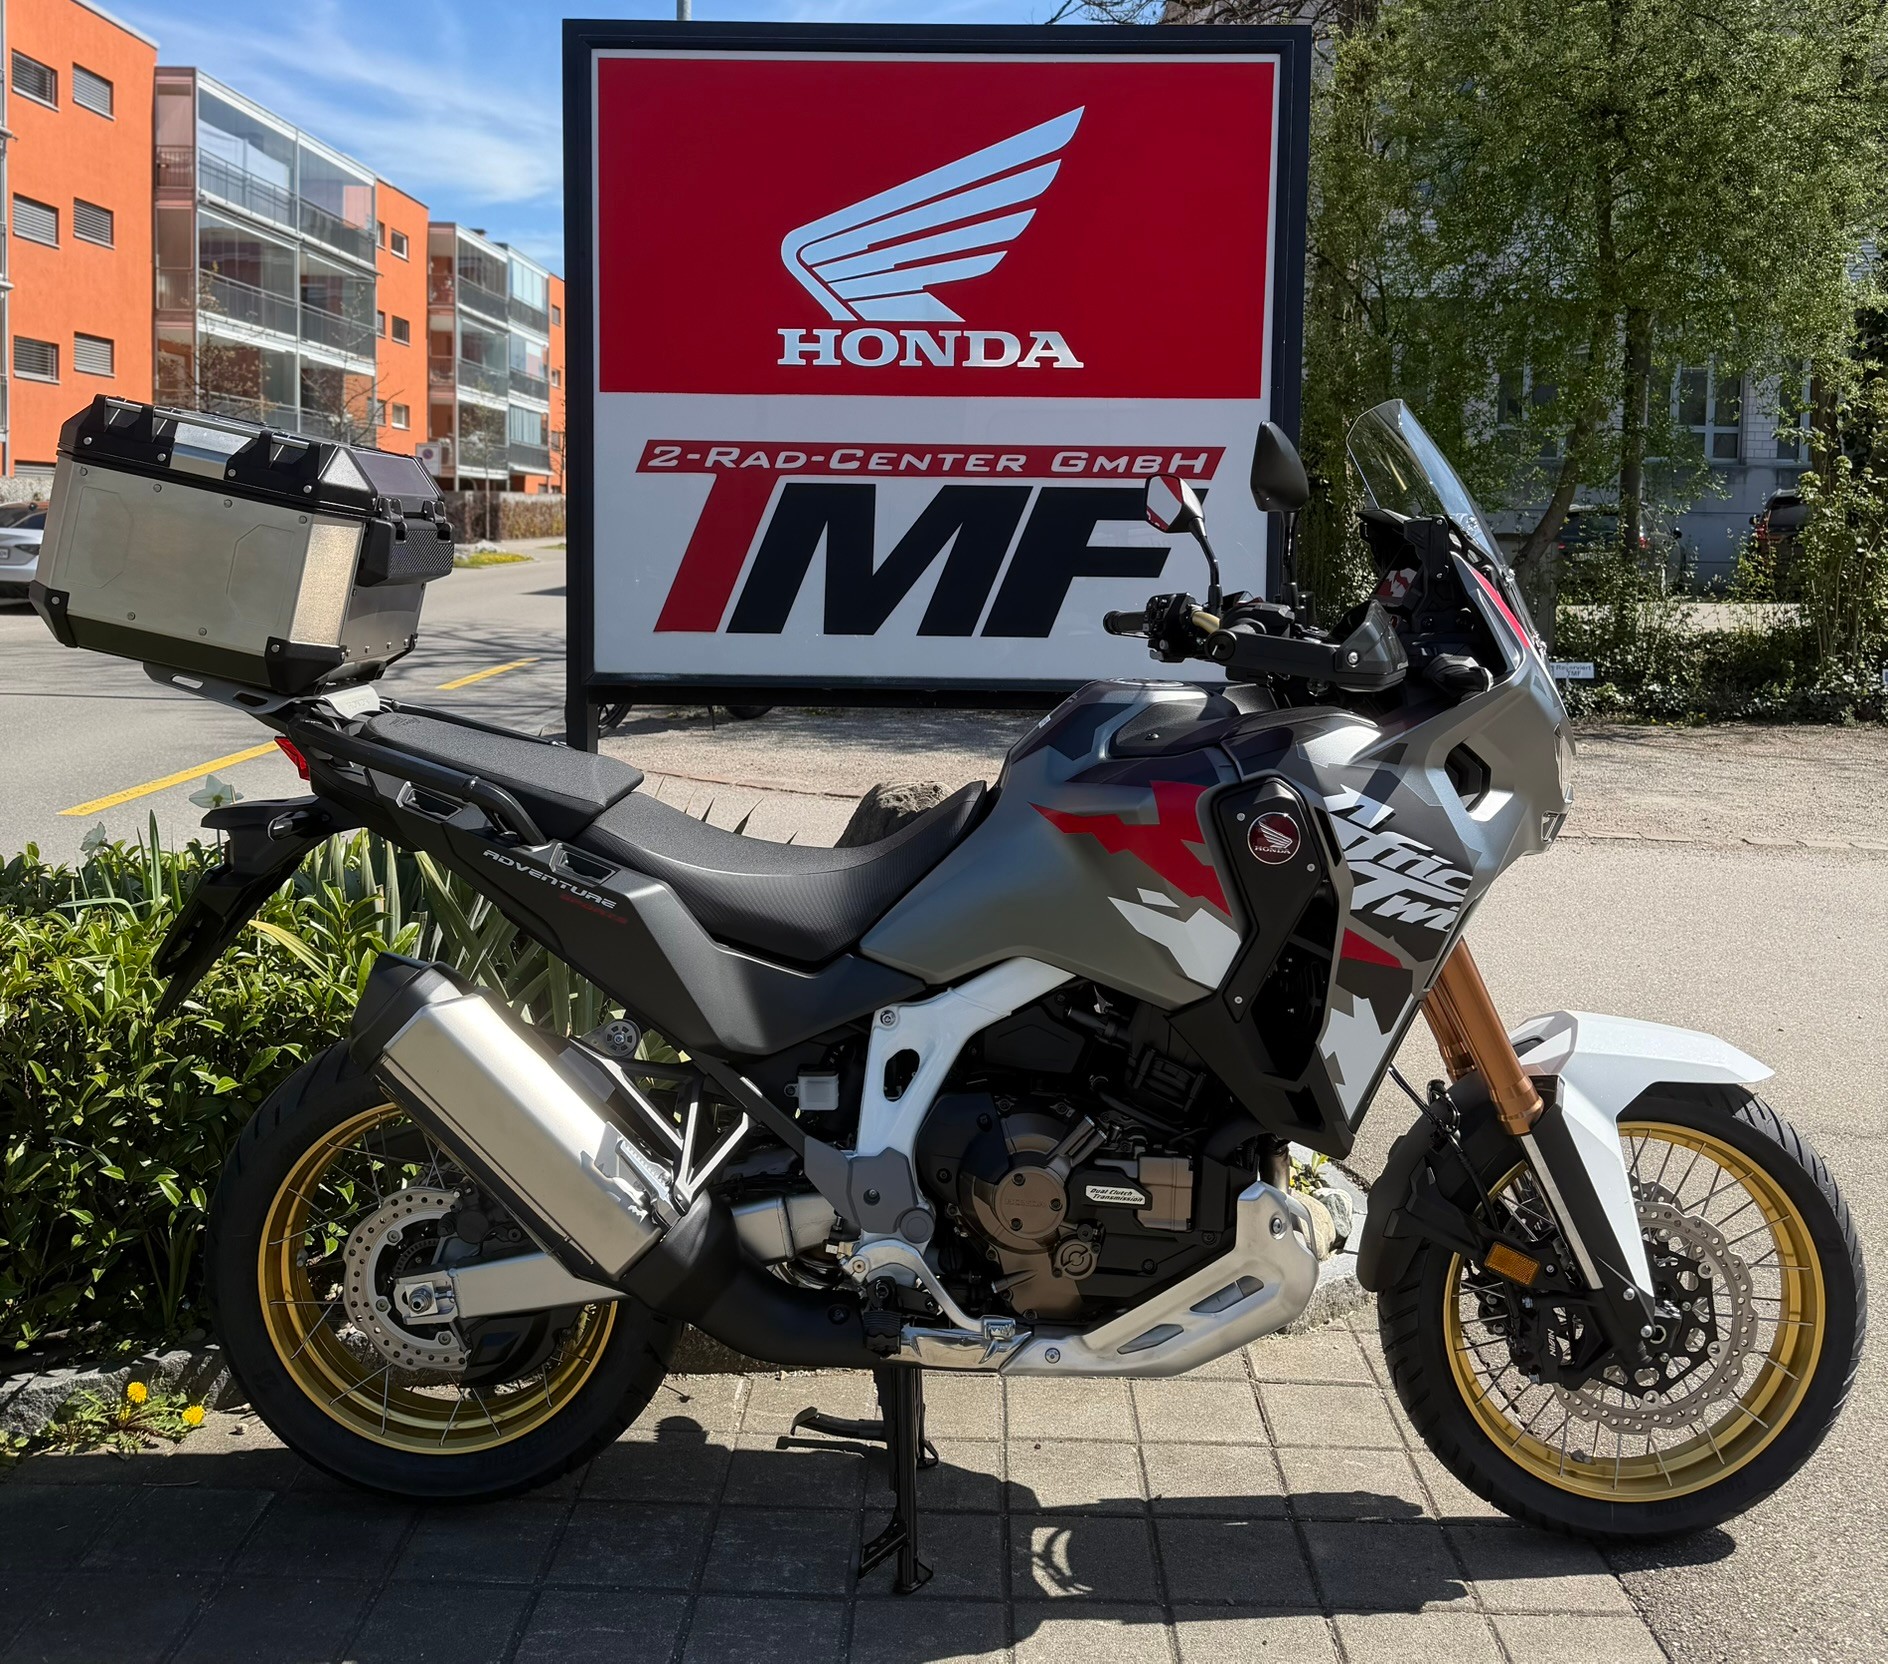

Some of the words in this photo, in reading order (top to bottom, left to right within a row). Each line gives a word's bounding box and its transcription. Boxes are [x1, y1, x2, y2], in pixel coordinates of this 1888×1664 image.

[778, 328, 1084, 369] HONDA
[652, 474, 1208, 638] TMF
[1254, 845, 1291, 855] HONDA
[483, 850, 617, 909] ADVENTURE
[1092, 1194, 1143, 1202] Transmission
